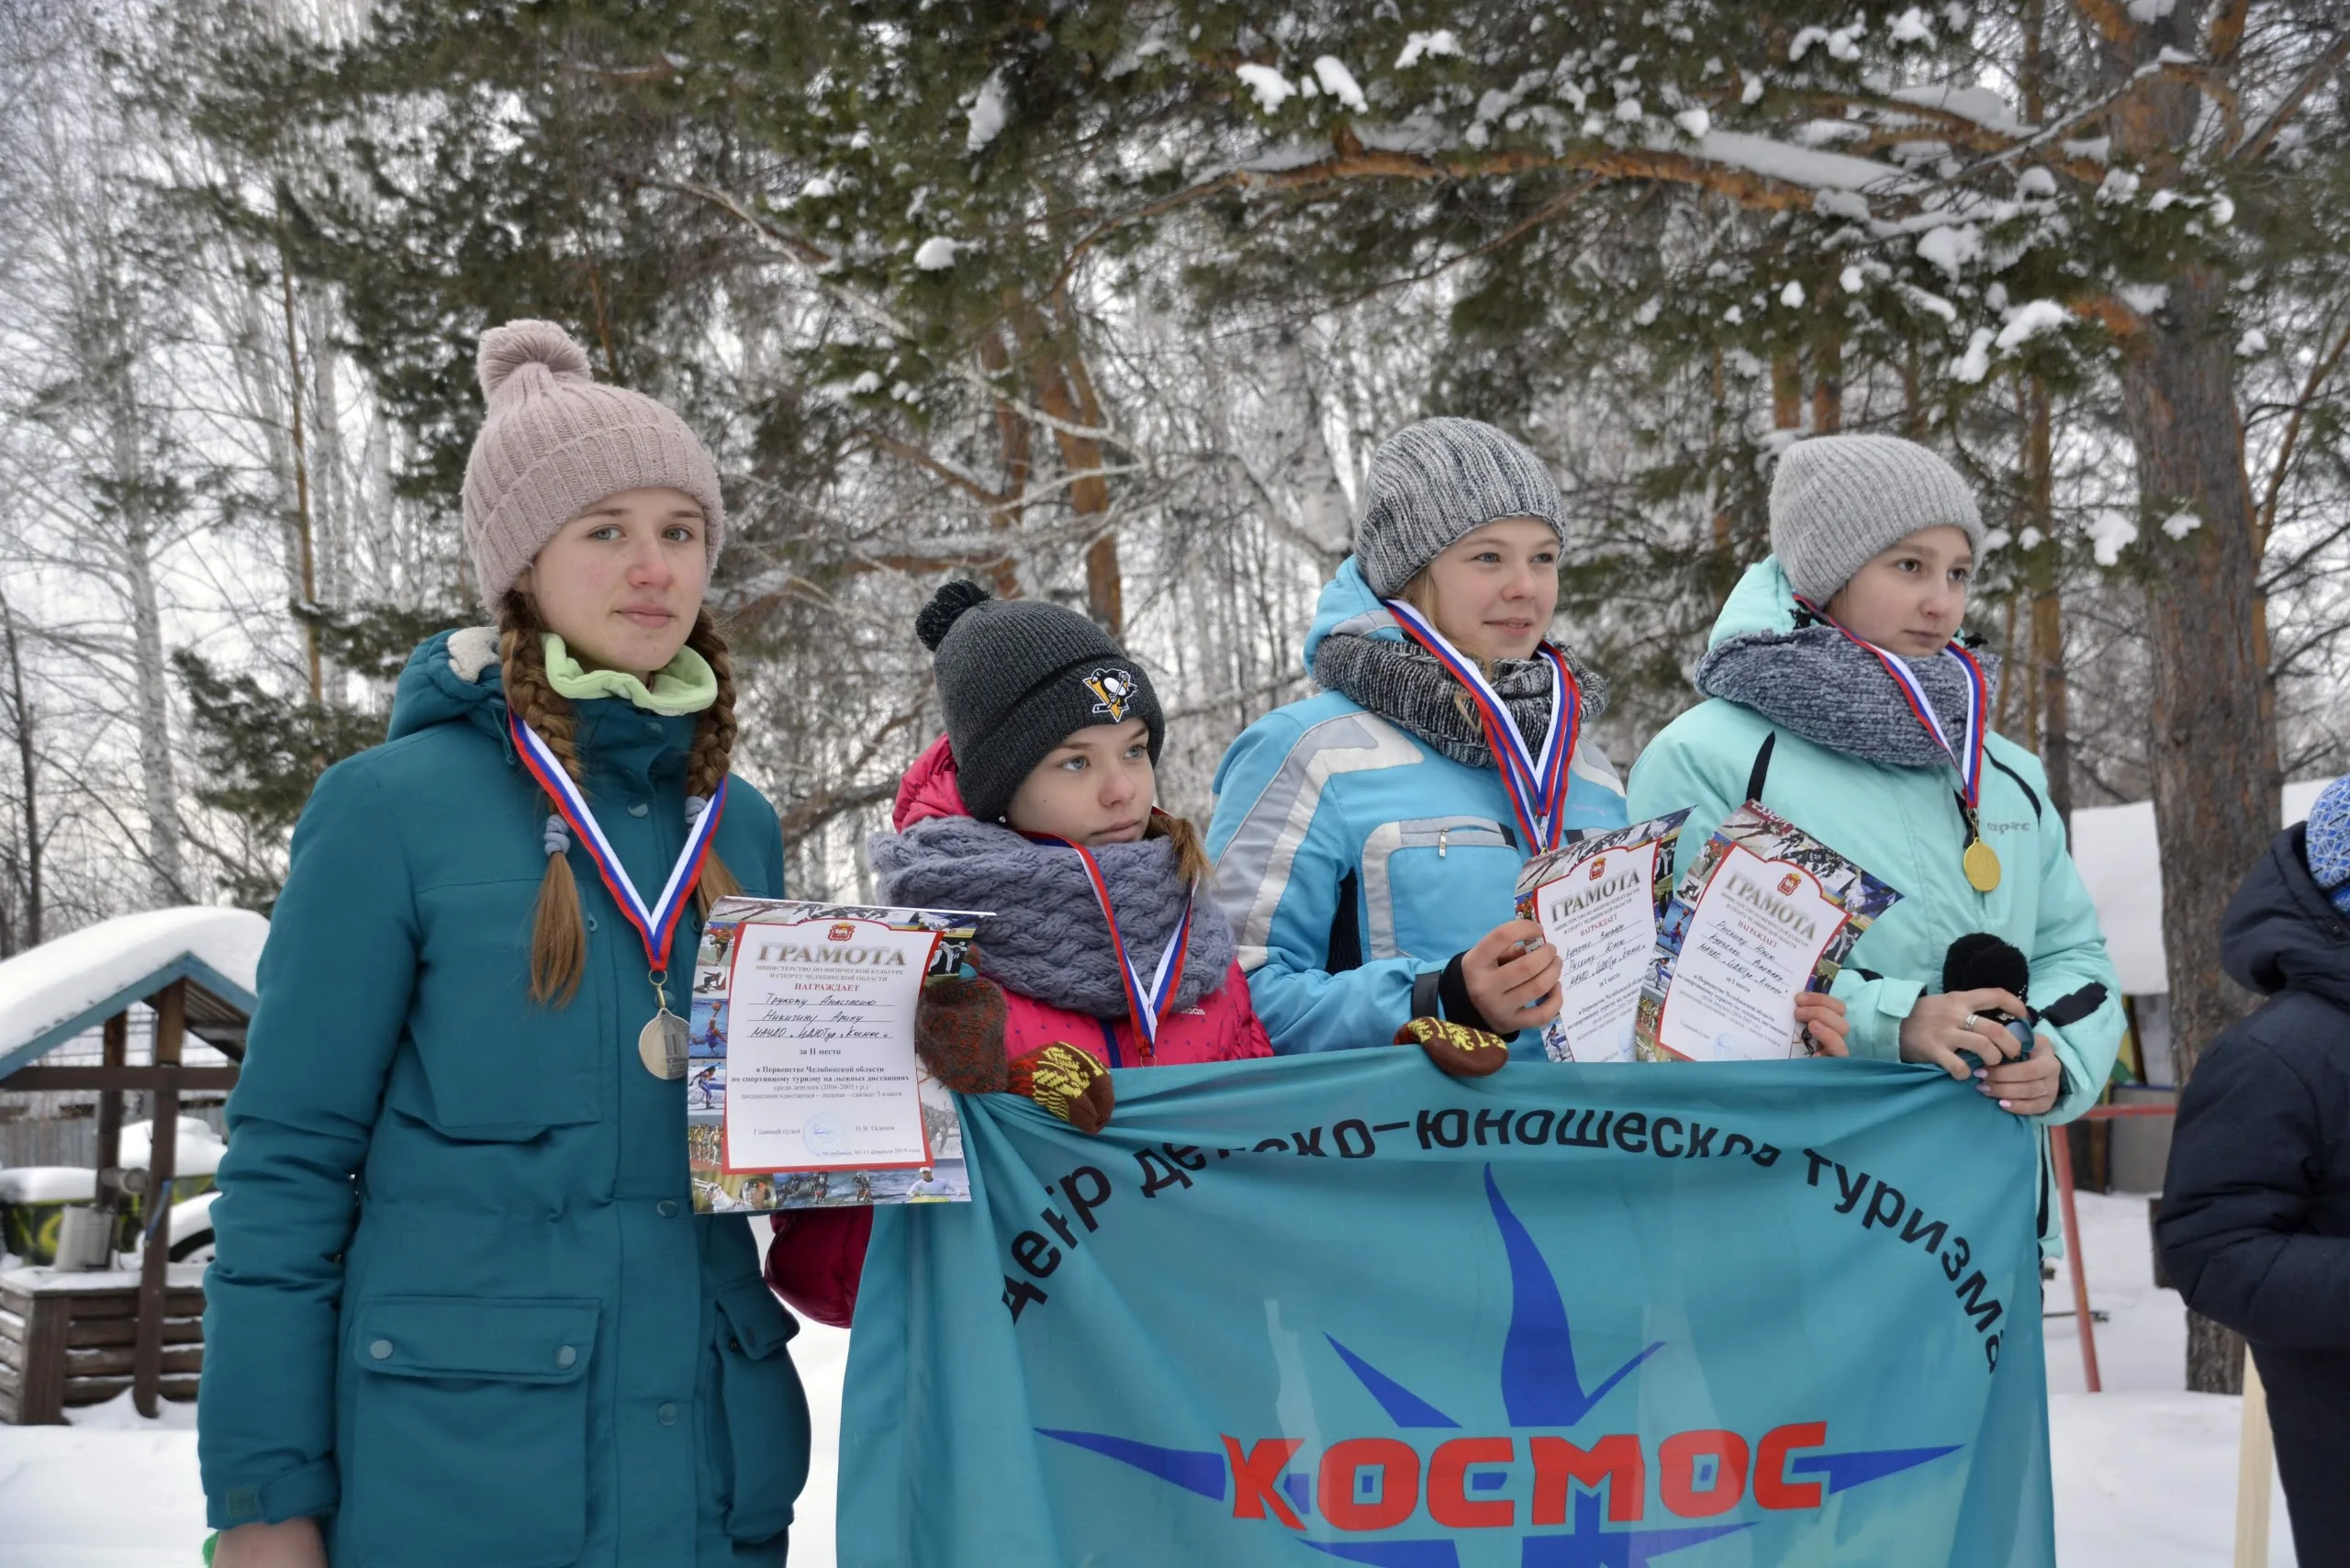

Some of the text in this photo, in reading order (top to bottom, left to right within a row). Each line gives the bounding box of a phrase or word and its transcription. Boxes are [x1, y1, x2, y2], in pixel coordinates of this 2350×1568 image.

[1550, 867, 1640, 924] ГРАМОТА
[1726, 872, 1817, 940] ГРАМОТА
[1580, 914, 1618, 936] НАГРАЖДАЕТ
[1737, 921, 1778, 947] НАГРАЖДАЕТ
[755, 941, 906, 966] ГРАМОТА
[805, 973, 855, 981] ЧЕЛЯБИНСКОЙ
[823, 967, 869, 975] ФИЗИЧЕСКОЙ
[794, 982, 860, 992] НАГРАЖДАЕТ
[762, 1009, 863, 1025] Никитину Арину
[762, 1066, 804, 1074] Первенстве
[1219, 1420, 1828, 1532] КОСМОС
